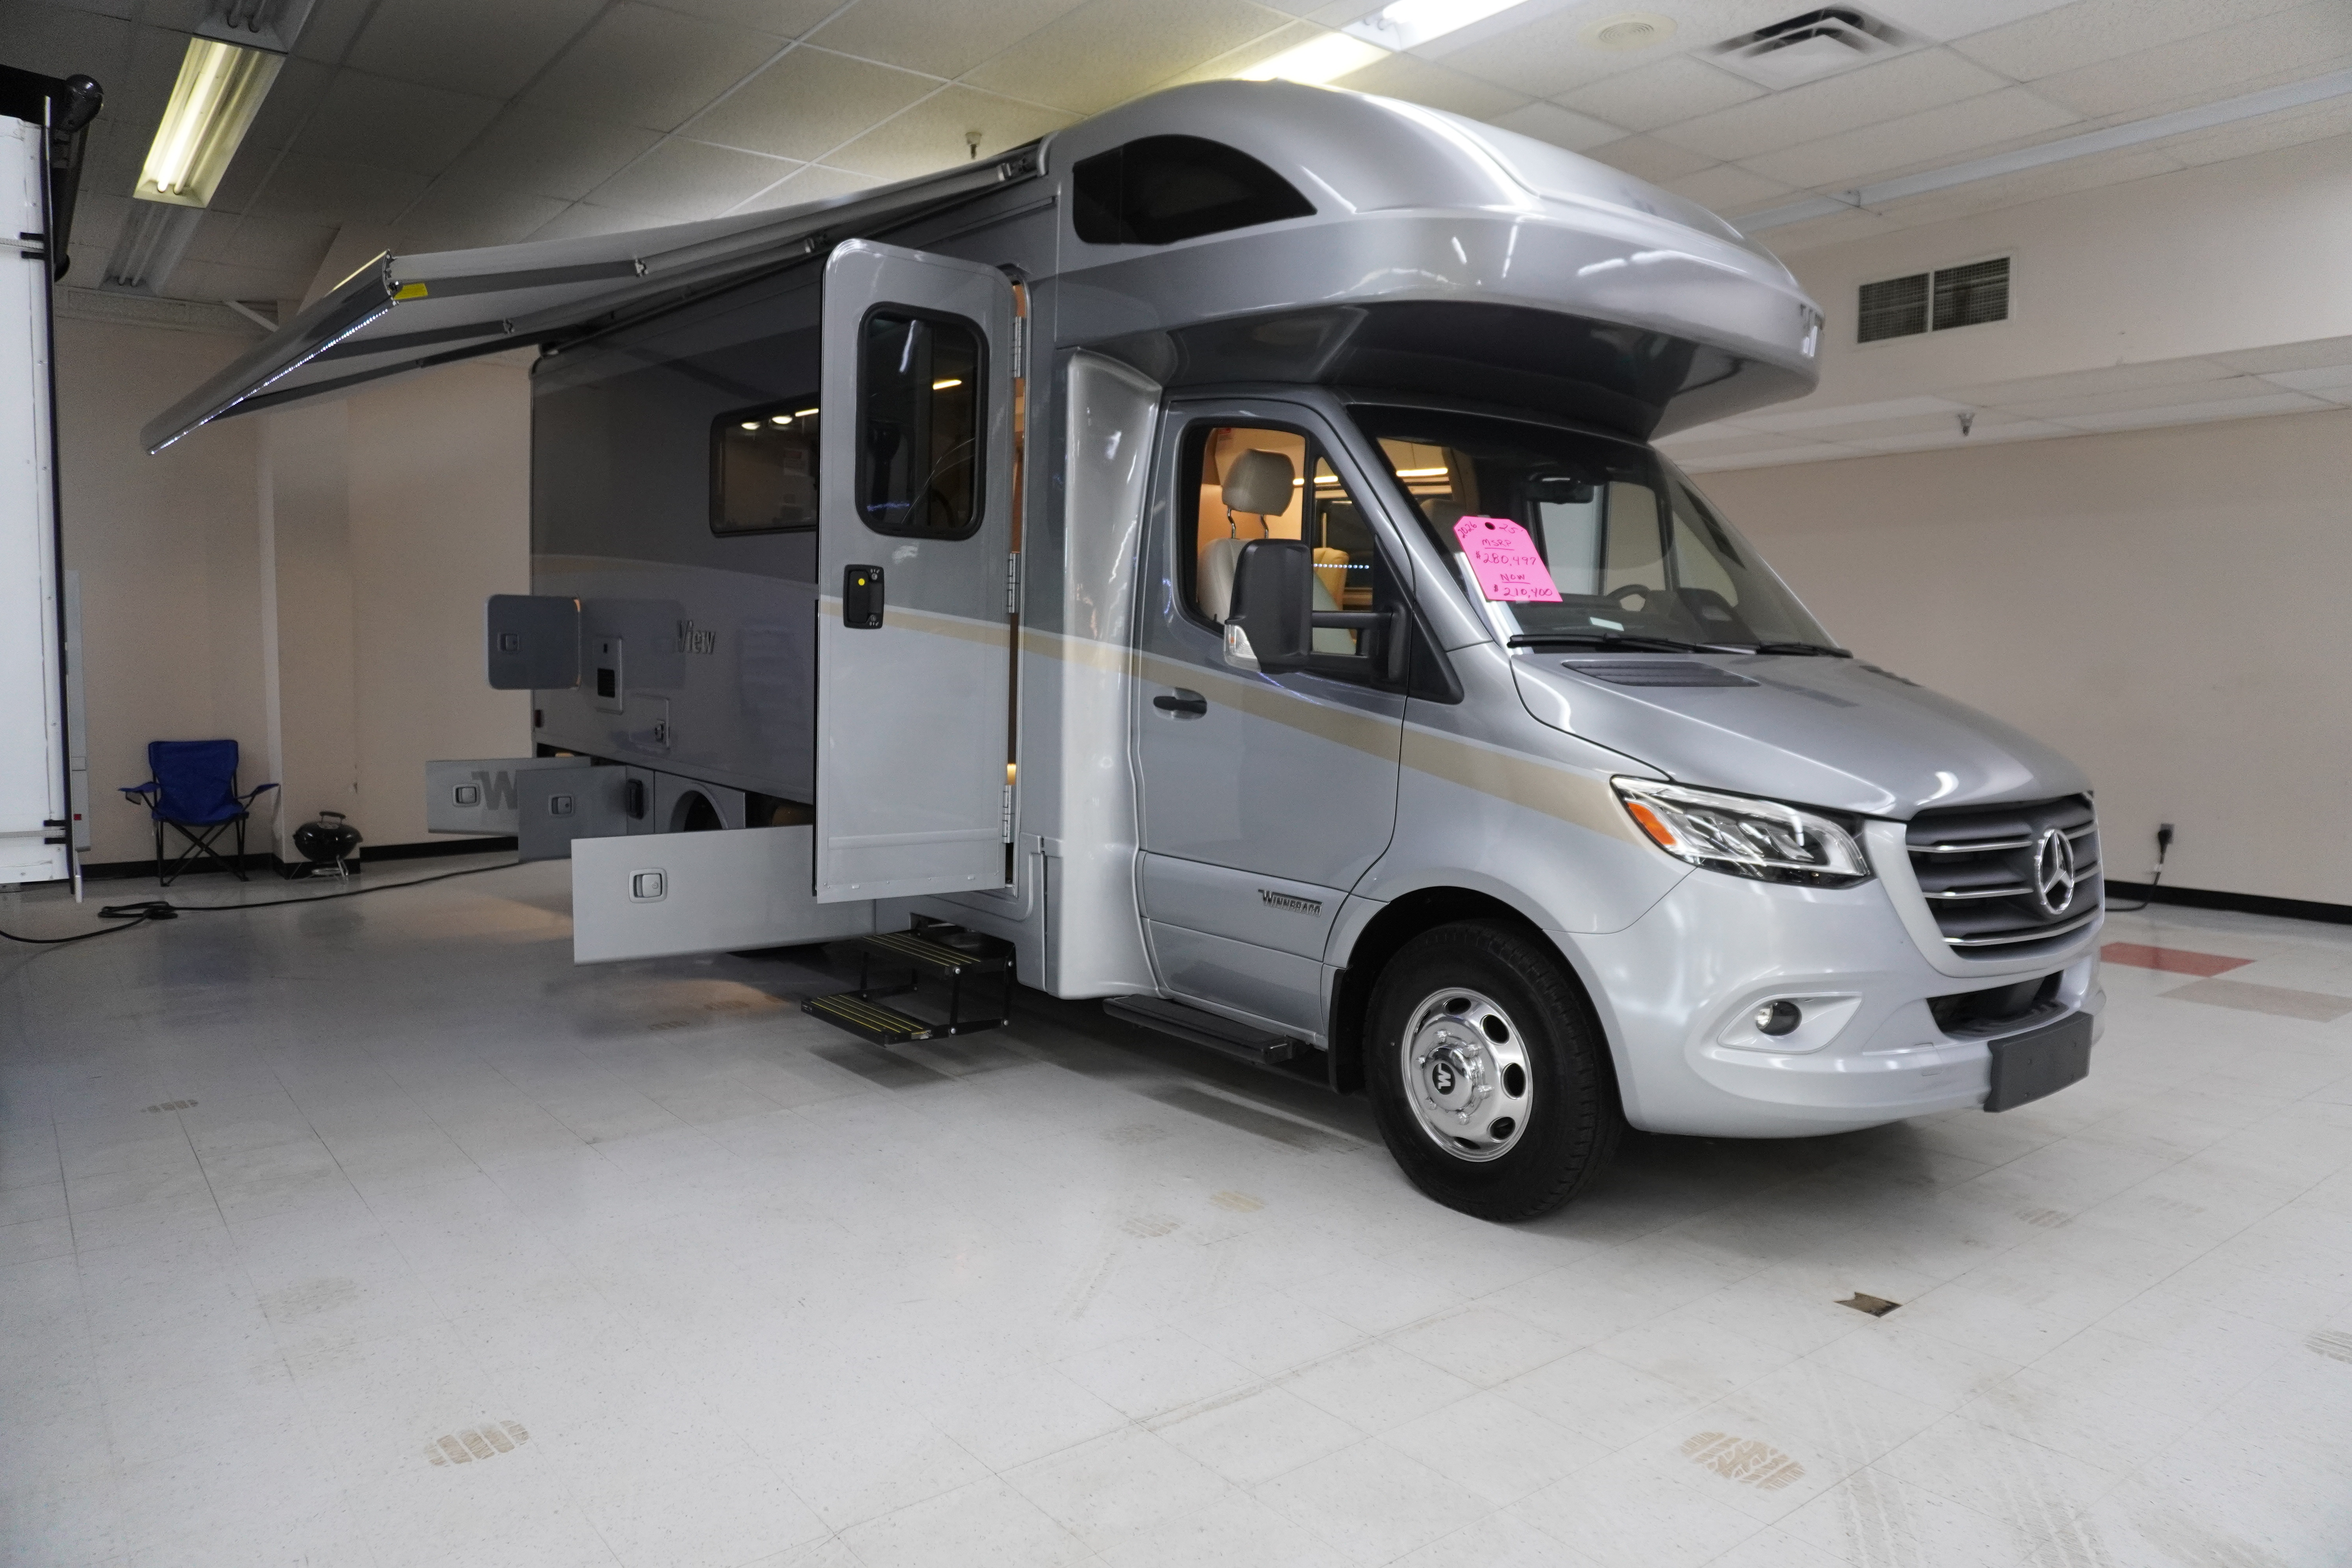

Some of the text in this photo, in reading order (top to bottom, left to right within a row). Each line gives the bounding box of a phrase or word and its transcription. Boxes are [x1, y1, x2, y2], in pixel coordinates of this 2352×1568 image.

[1457, 521, 1477, 539] 2026
[1482, 539, 1512, 547] MSRP
[1500, 573, 1525, 582] NOW
[677, 619, 716, 655] View
